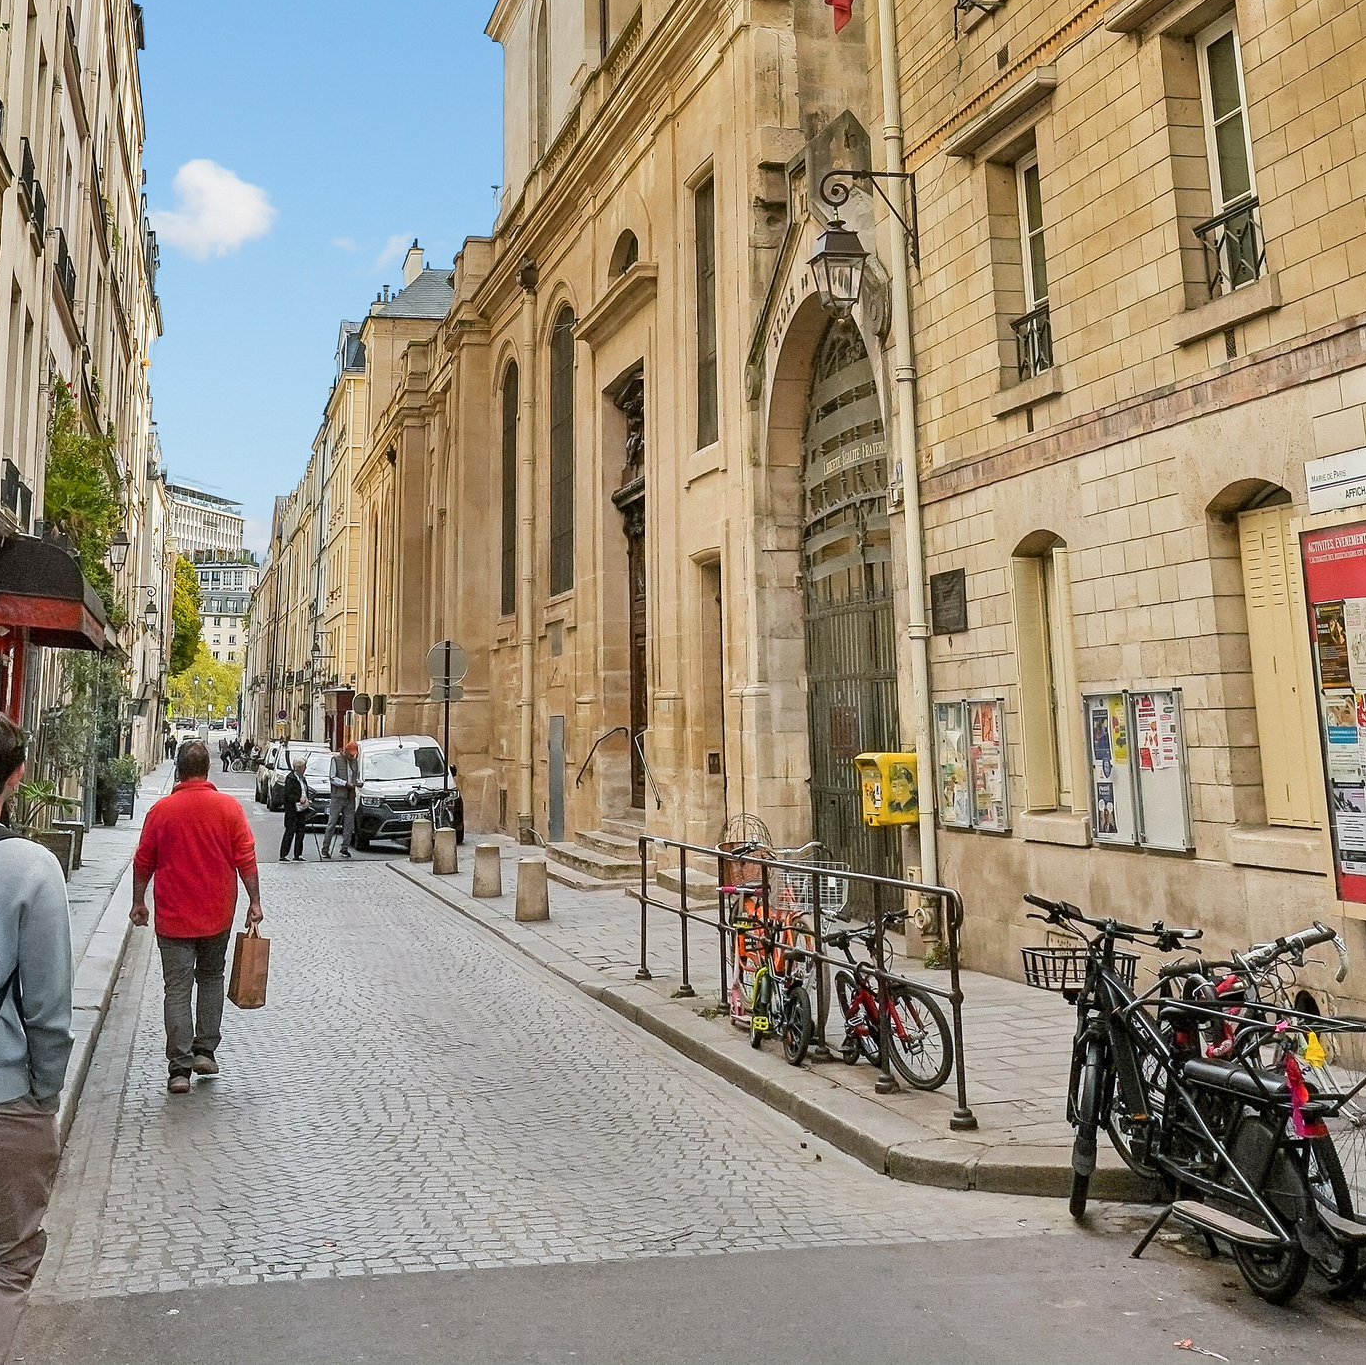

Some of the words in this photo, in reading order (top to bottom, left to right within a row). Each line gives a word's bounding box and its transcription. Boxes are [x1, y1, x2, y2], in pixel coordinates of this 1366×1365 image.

[1311, 474, 1327, 483] MAIRIE
[1327, 472, 1333, 480] DE
[1333, 469, 1347, 479] PARIS
